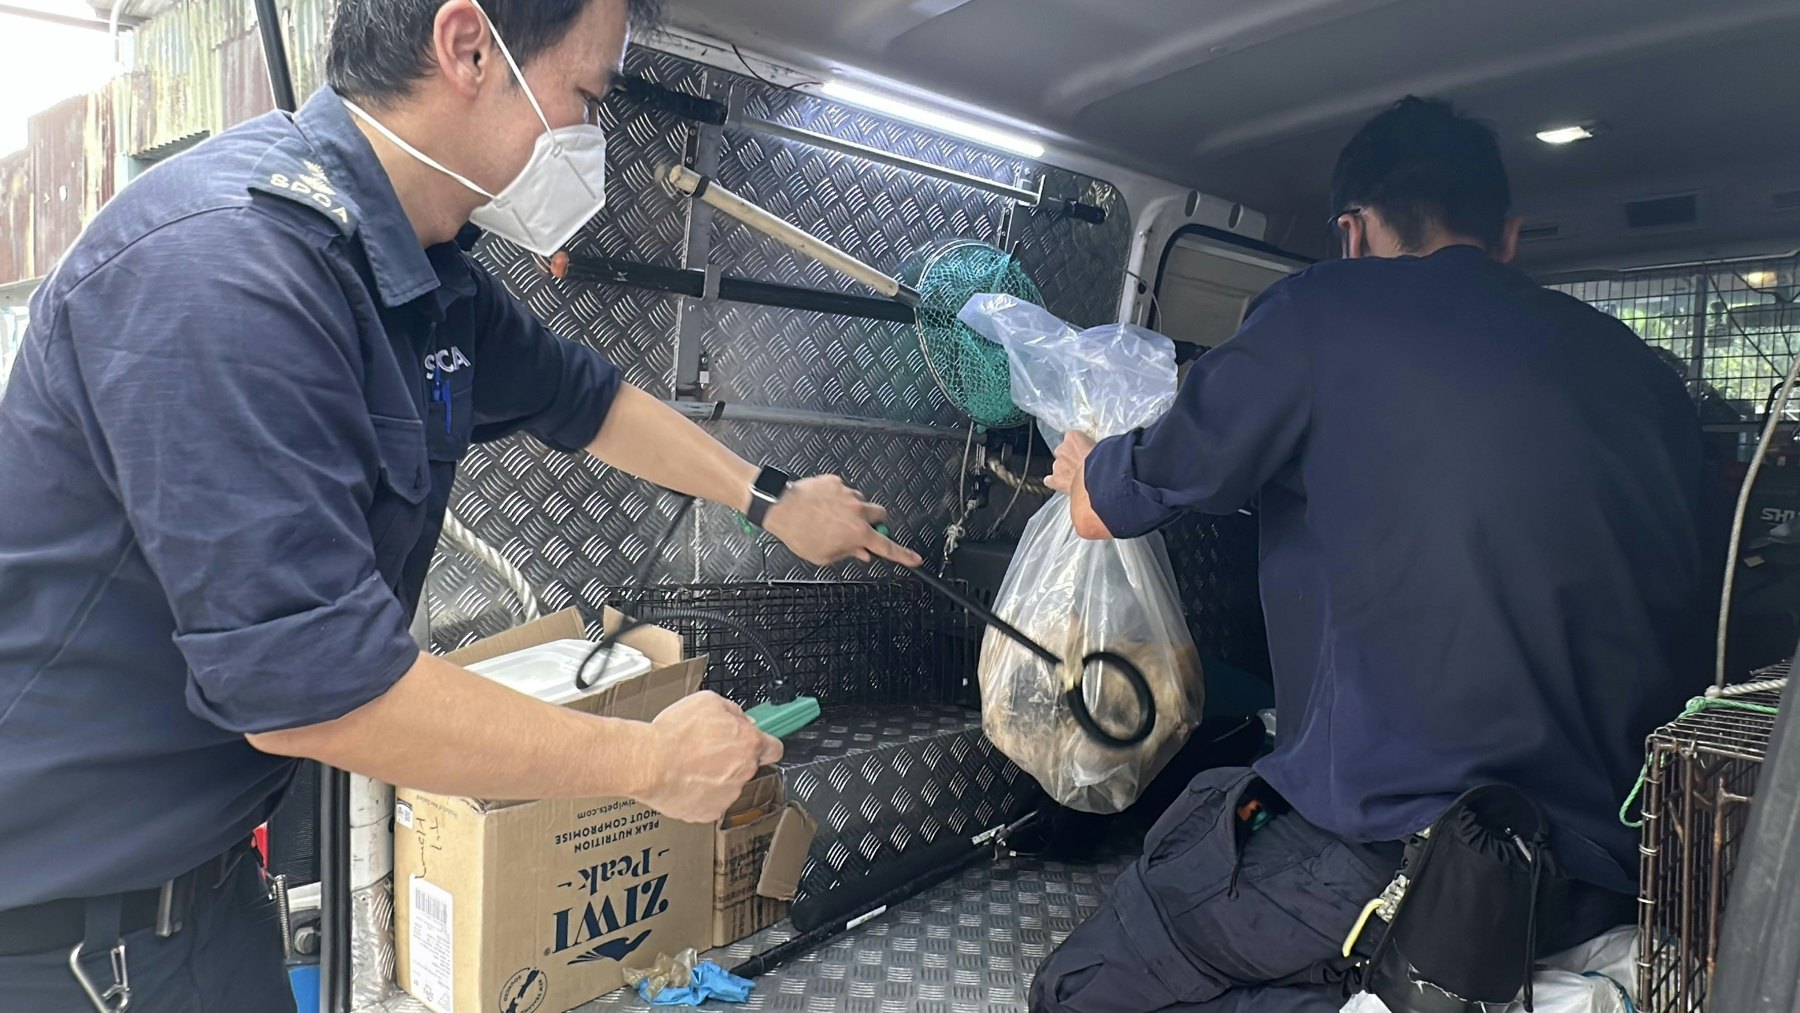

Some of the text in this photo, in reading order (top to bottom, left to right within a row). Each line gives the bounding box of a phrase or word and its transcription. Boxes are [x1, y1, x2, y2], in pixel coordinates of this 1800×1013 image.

[269, 173, 348, 224] SPCA
[424, 345, 472, 380] SCA
[555, 809, 661, 845] HOUT COMPROMISE
[574, 819, 660, 853] PEAK NUTRITION
[552, 872, 670, 954] ZIWI
